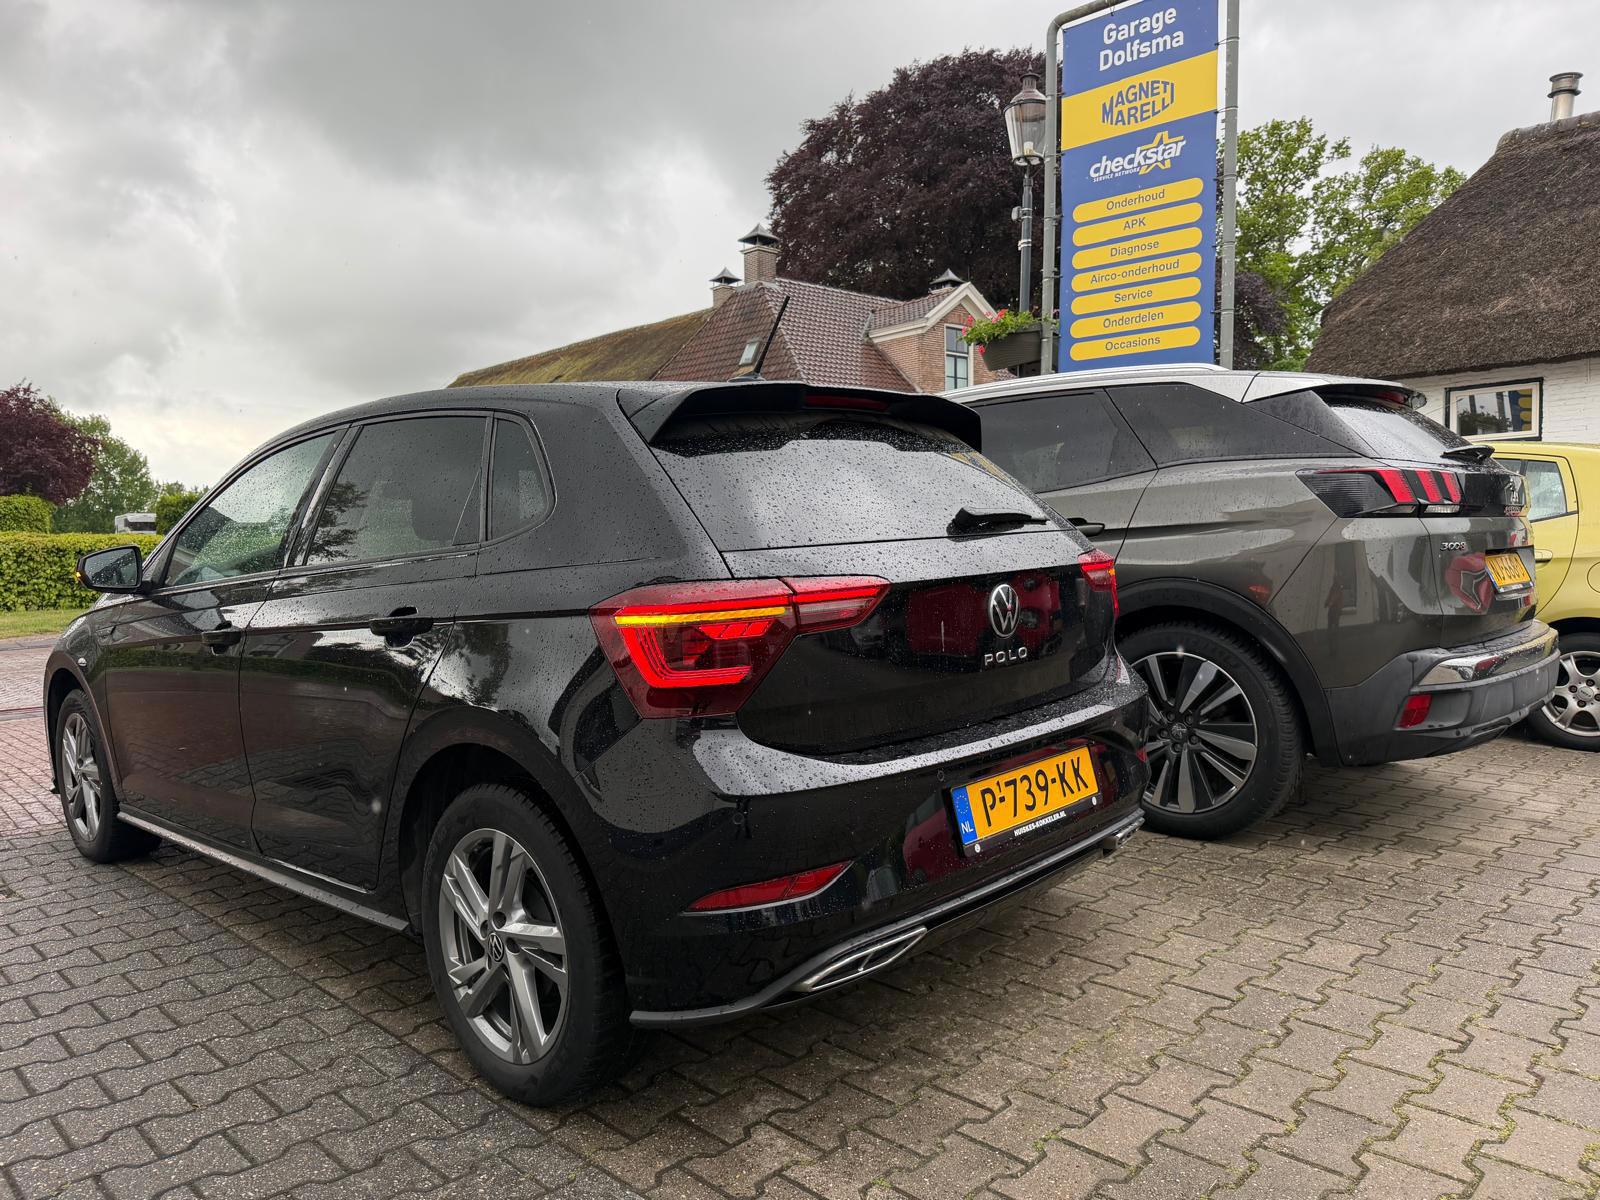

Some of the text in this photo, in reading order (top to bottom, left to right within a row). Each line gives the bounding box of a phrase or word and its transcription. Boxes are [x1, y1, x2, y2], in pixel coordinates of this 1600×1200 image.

[1103, 7, 1177, 45] Garage
[1099, 30, 1184, 71] Dolfsma
[1101, 80, 1175, 125] MAGNETI
[1101, 83, 1175, 126] MARELLI
[1089, 140, 1187, 178] checkstar
[1106, 189, 1166, 211] Onderhoud
[1123, 217, 1146, 231] APK
[1110, 240, 1160, 257] Diagnose
[1090, 259, 1180, 285] Airco-onderhoud
[1114, 289, 1153, 303] Service
[1103, 311, 1164, 329] Onderdelen
[1105, 336, 1161, 351] Occasions
[984, 646, 1028, 666] POLO
[960, 822, 974, 834] NL
